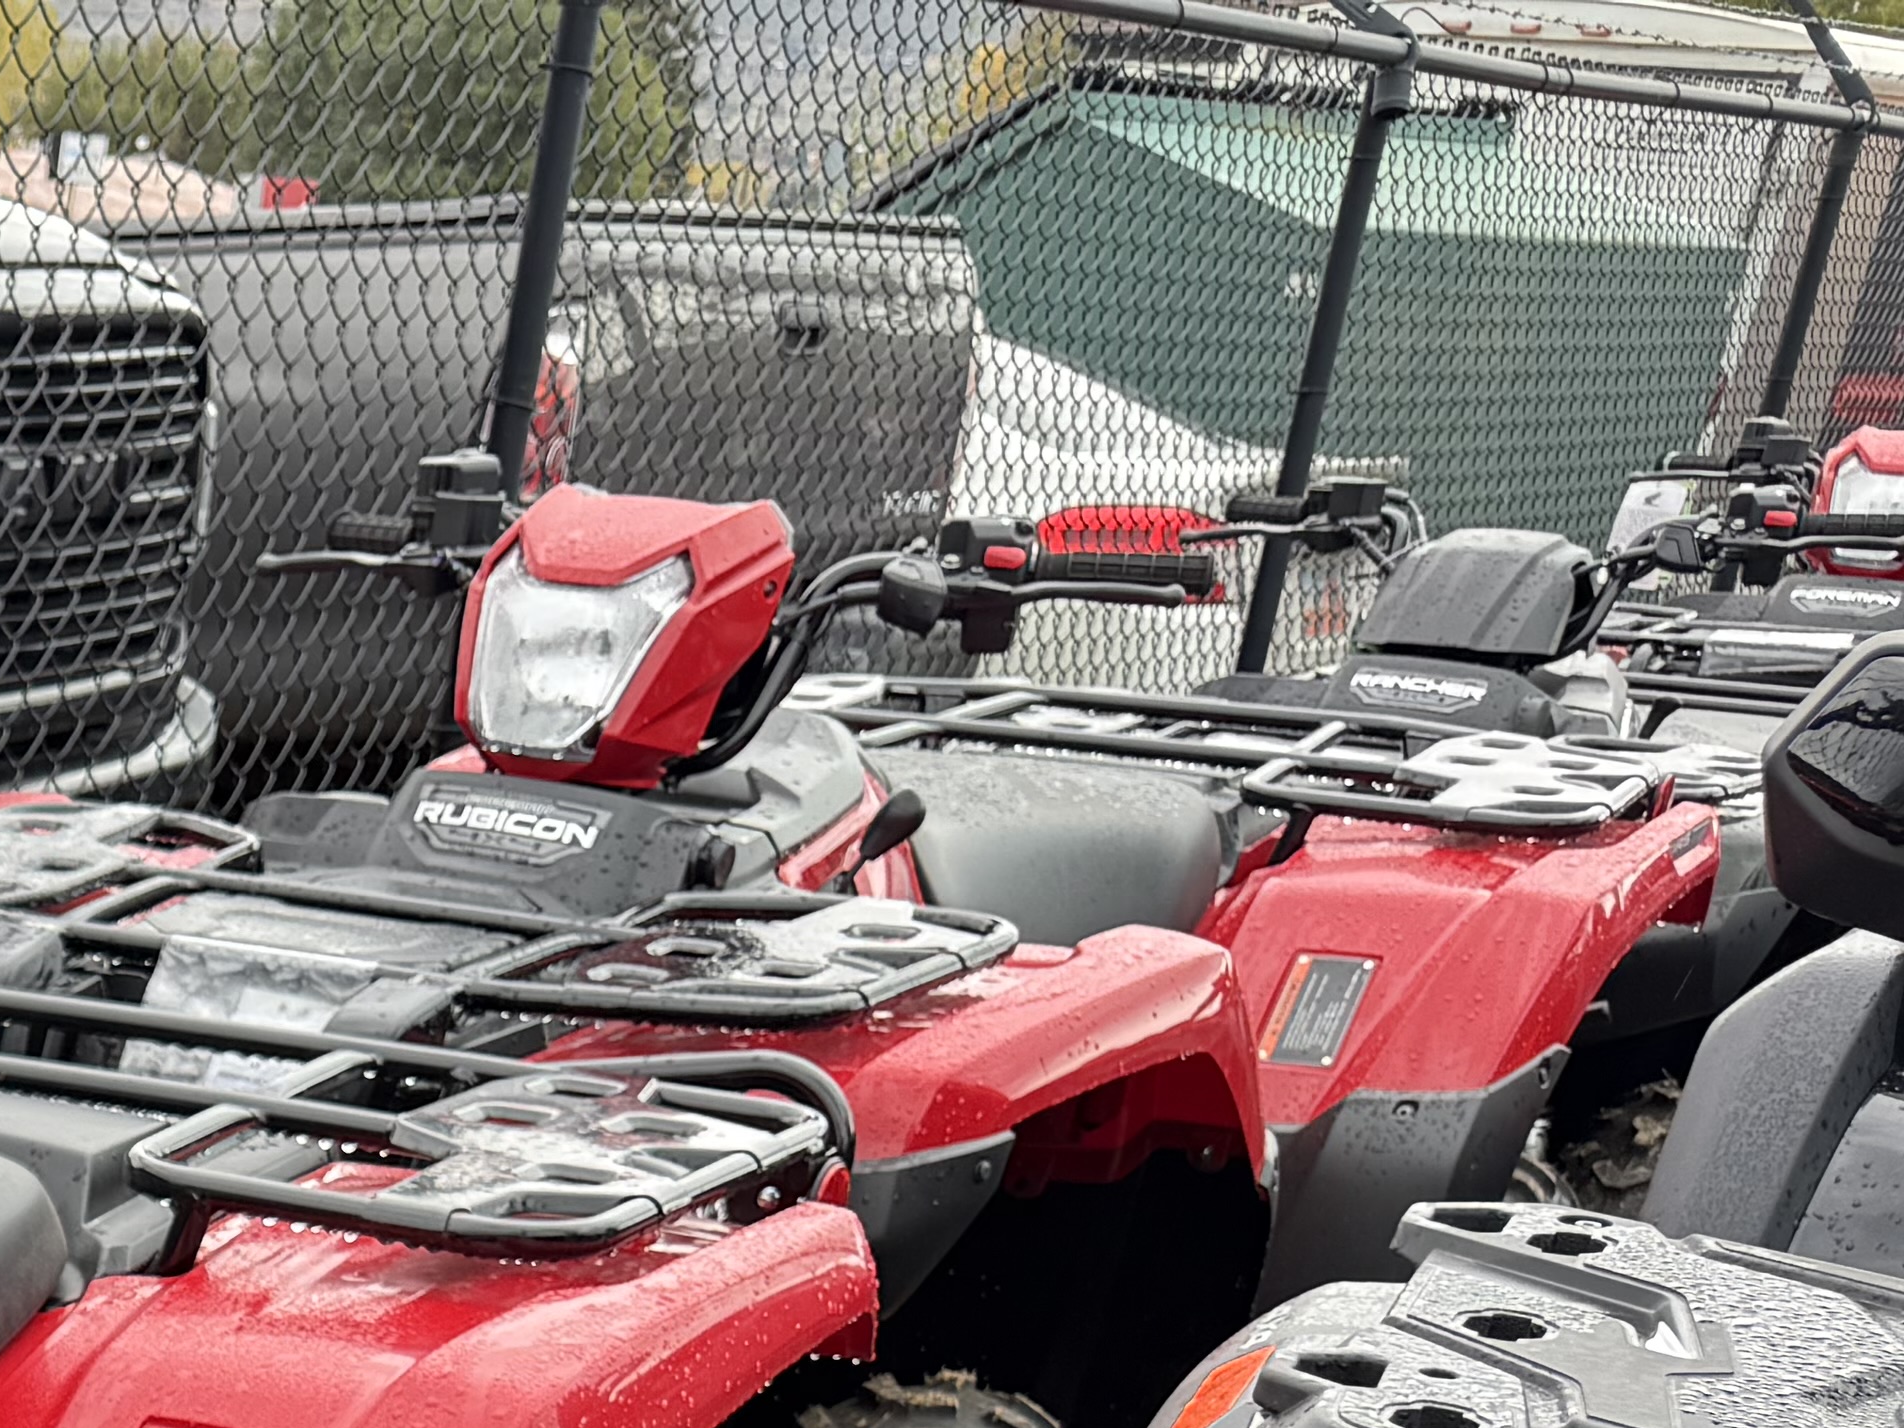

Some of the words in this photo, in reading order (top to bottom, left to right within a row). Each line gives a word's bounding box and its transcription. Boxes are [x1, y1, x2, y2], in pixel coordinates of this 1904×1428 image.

[1789, 588, 1902, 608] FOREMAN
[1350, 673, 1488, 702] RANCHER
[413, 800, 600, 850] RUBICON
